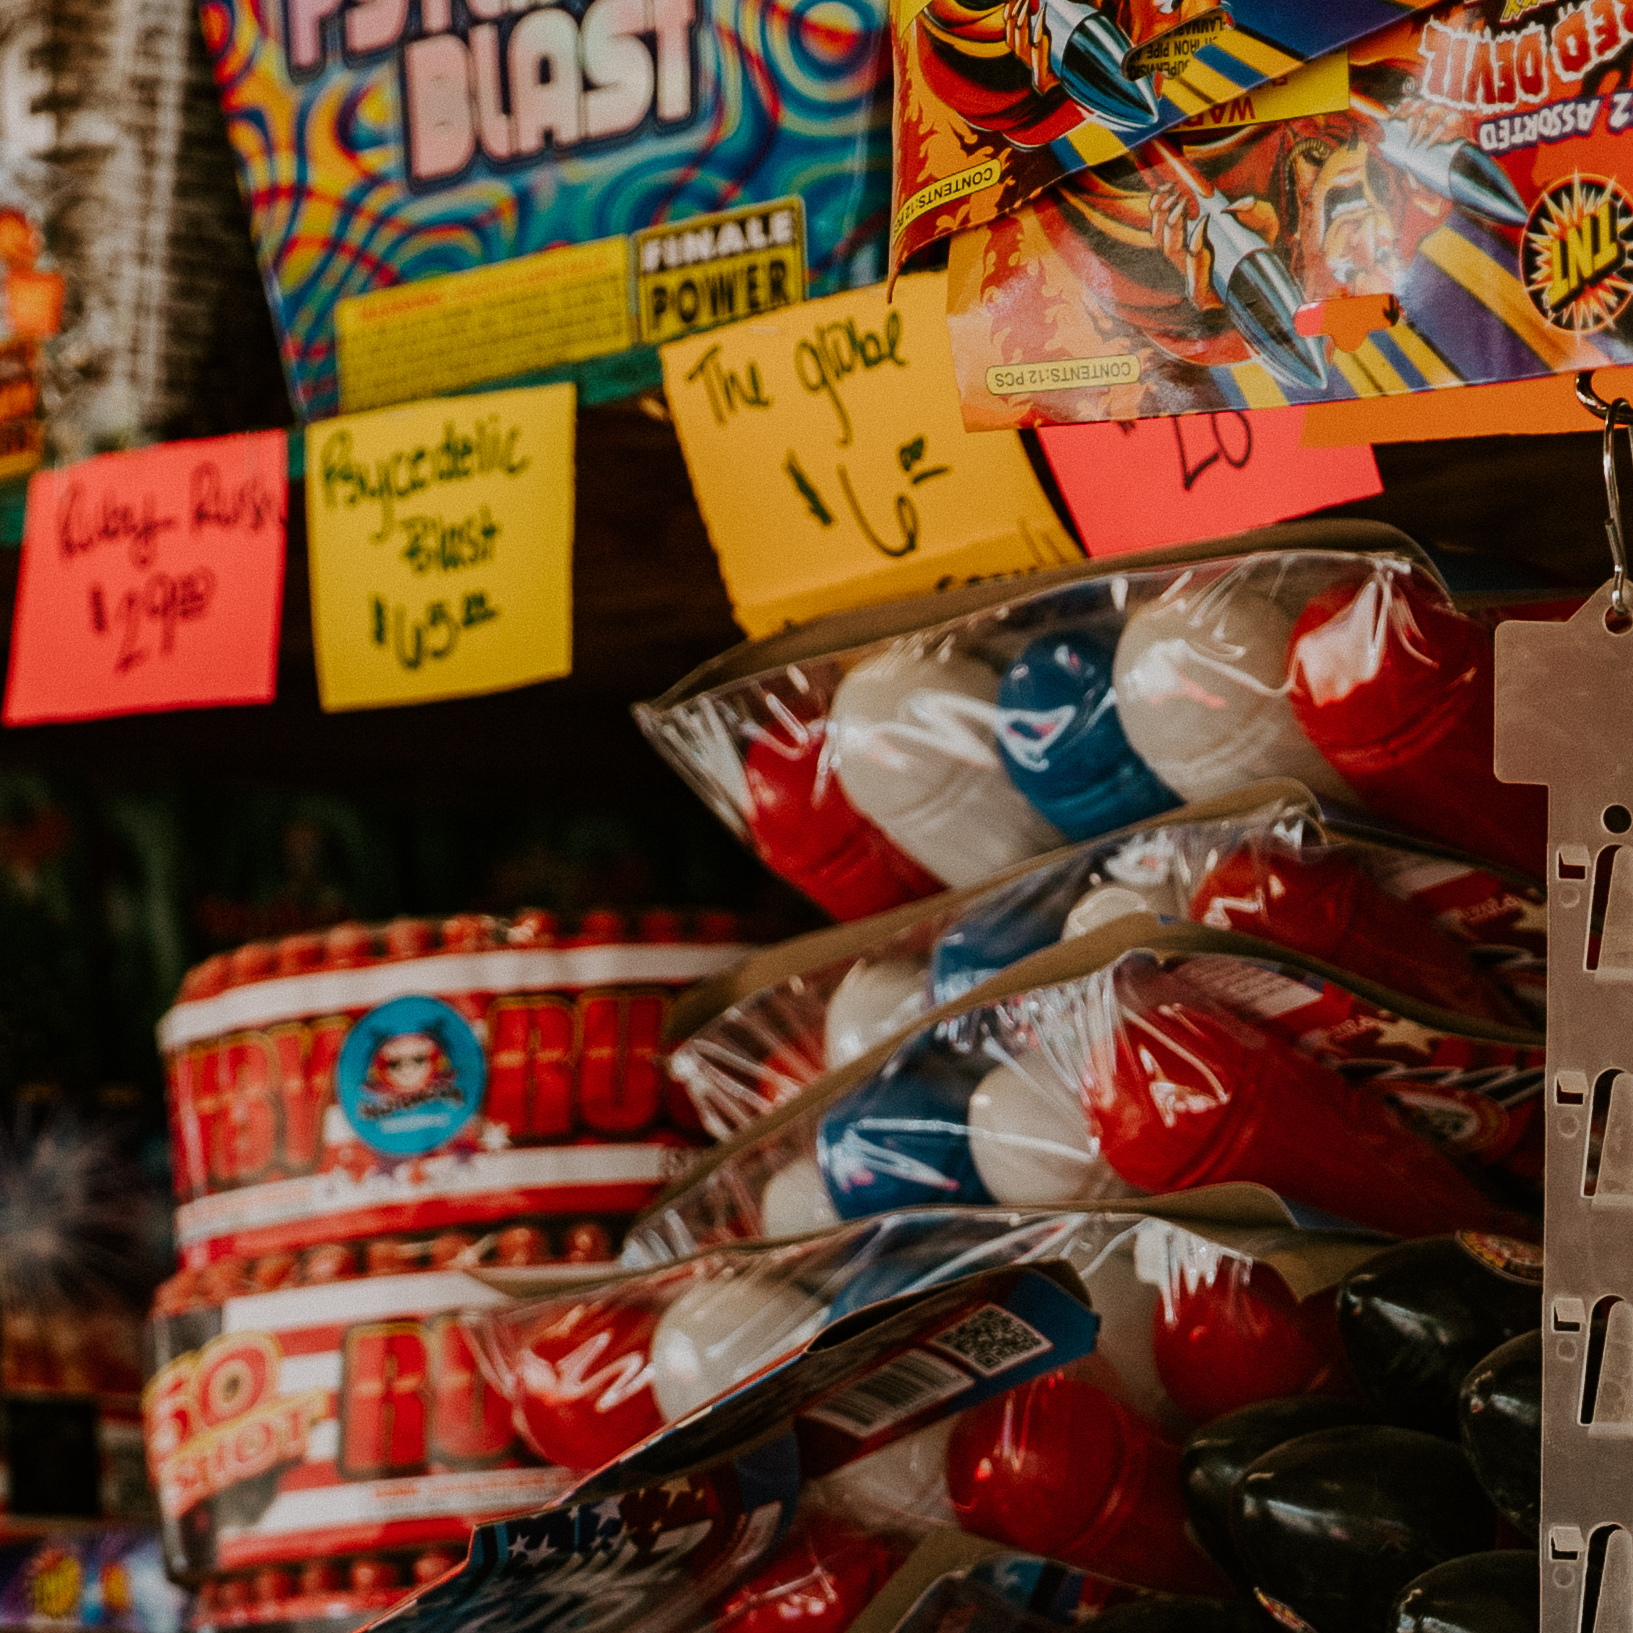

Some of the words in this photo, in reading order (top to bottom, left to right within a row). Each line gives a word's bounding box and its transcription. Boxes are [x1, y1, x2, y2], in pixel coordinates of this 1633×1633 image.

[404, 0, 697, 181] BLAST
[1419, 15, 1550, 113] DEVIL
[1479, 98, 1602, 150] ASSORTED
[641, 210, 795, 273] FINALE
[1547, 201, 1618, 308] TNT
[649, 271, 793, 335] POWER
[1026, 361, 1132, 384] CONTENTS:12
